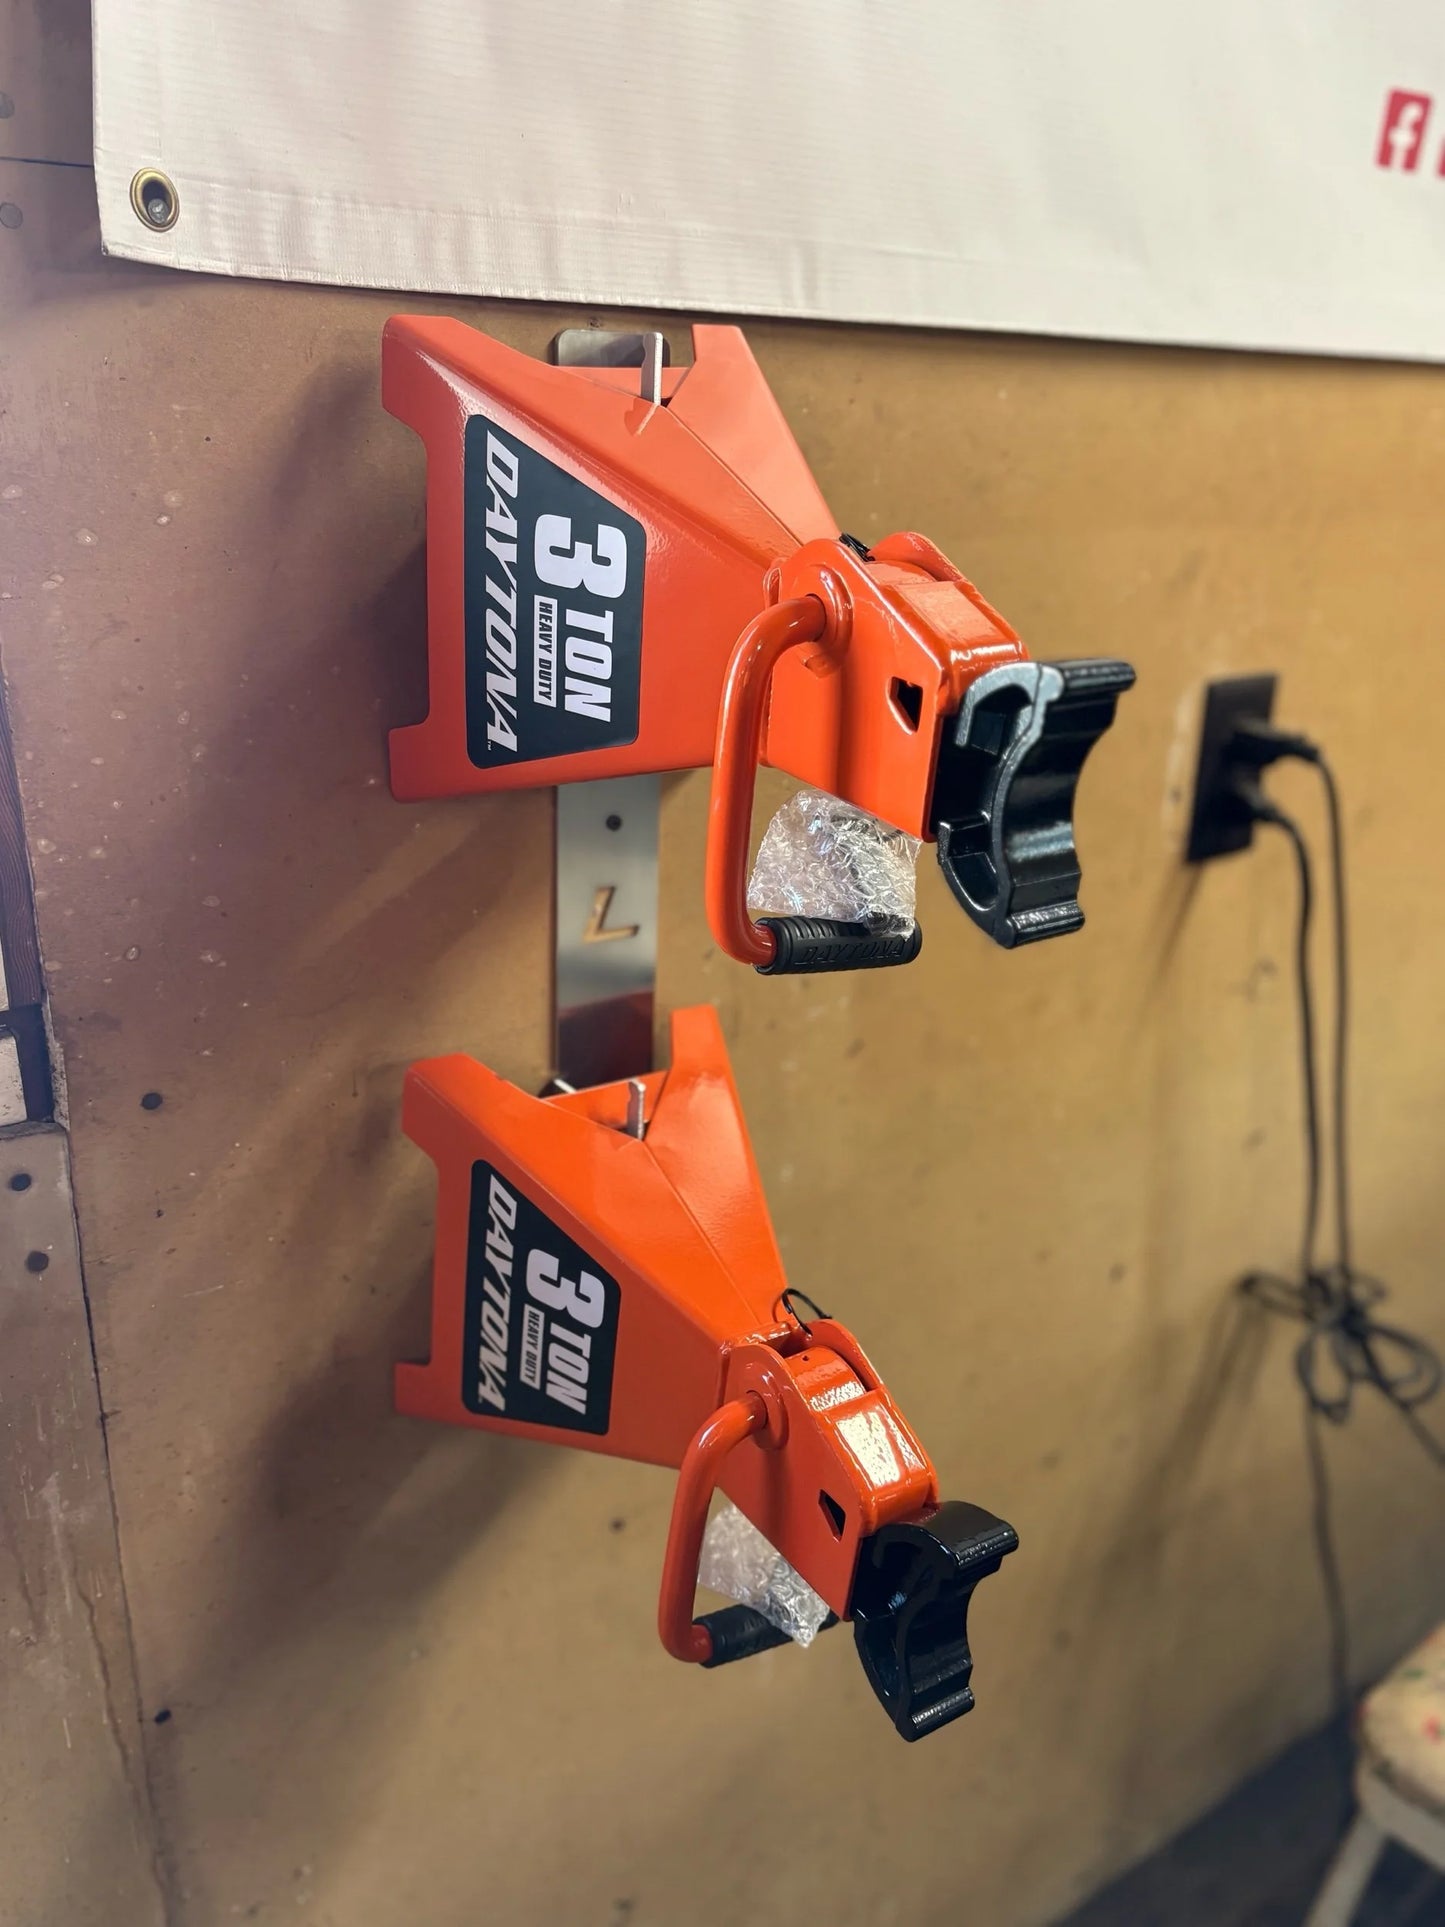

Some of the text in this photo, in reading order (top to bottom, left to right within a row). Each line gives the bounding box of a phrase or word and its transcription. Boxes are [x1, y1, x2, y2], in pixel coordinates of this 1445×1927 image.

[486, 429, 519, 752] DAYTONA
[533, 513, 627, 722] 3 TON
[538, 601, 554, 702] HEAVY DUTY
[478, 1174, 517, 1411] DAYTONA
[525, 1310, 541, 1384] HEAVY DUTY
[526, 1248, 605, 1415] 3 TON
